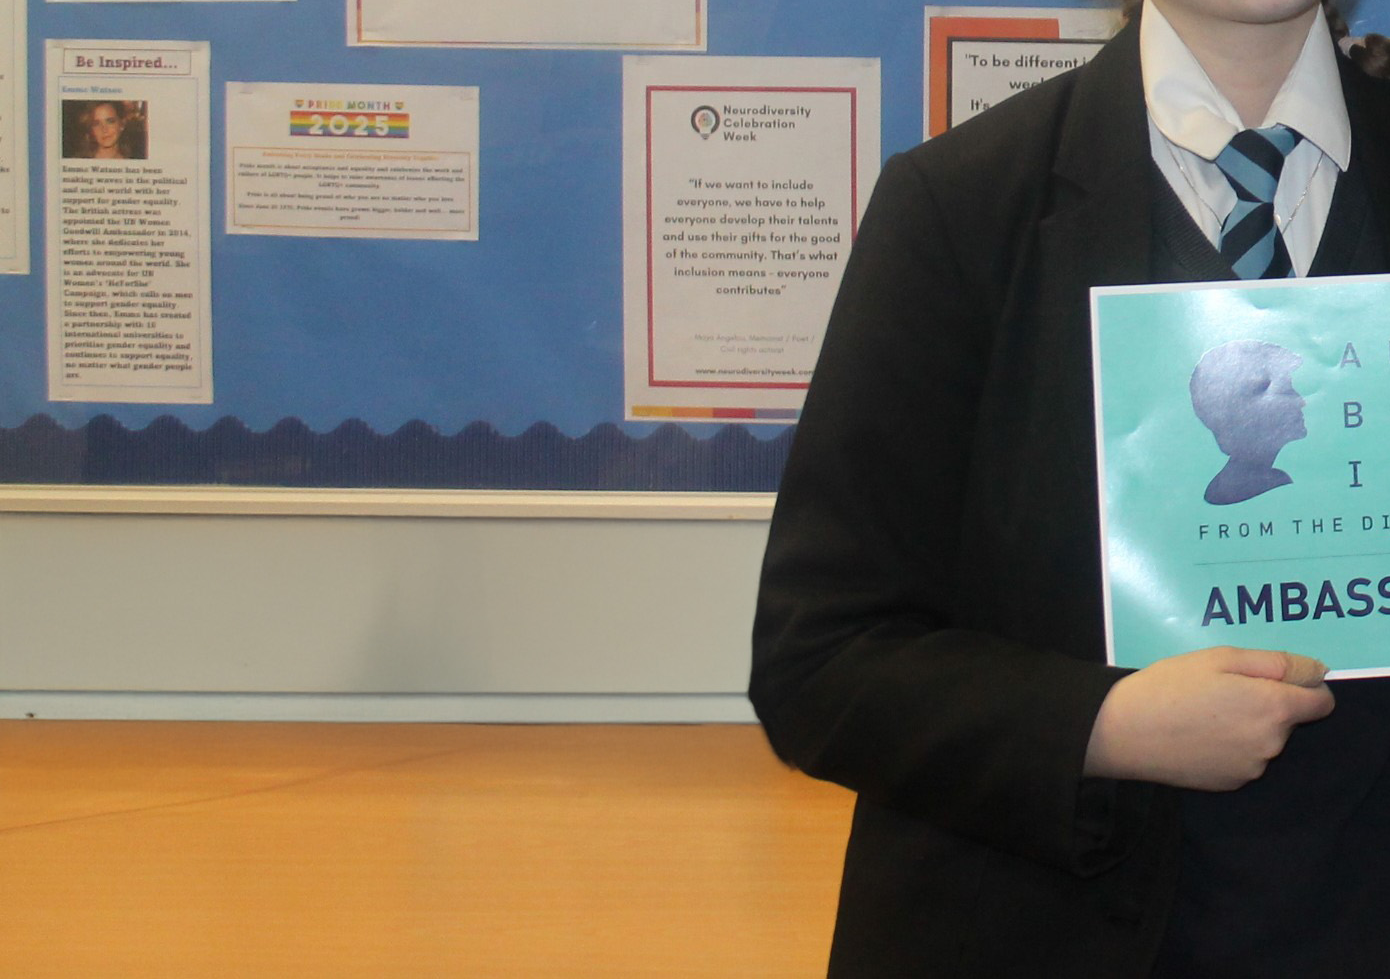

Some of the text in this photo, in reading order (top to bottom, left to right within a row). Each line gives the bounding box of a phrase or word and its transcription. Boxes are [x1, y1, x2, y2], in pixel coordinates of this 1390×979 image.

[76, 56, 177, 71] Be Inspired...
[965, 53, 1078, 68] "To be different
[723, 105, 812, 118] Neurodiversity
[308, 114, 390, 137] 2025
[723, 118, 796, 129] Celebration
[723, 132, 757, 142] Week
[689, 178, 701, 188] "If
[725, 180, 753, 189] want
[757, 181, 768, 190] to
[772, 179, 813, 190] include
[677, 200, 731, 209] everyone,
[755, 196, 782, 207] have
[786, 198, 797, 207] to
[801, 197, 825, 210] help
[665, 214, 838, 228] everyone develop their talents
[663, 231, 684, 242] and
[711, 231, 736, 242] their
[741, 231, 766, 245] gifts
[770, 231, 785, 242] for
[790, 232, 807, 242] the
[811, 232, 840, 245] good
[666, 249, 837, 262] of the community. That's what
[674, 267, 724, 278] inclusion
[729, 270, 766, 278] means
[777, 270, 829, 281] everyone
[1199, 520, 1275, 541] FROM
[1292, 516, 1345, 535] THE
